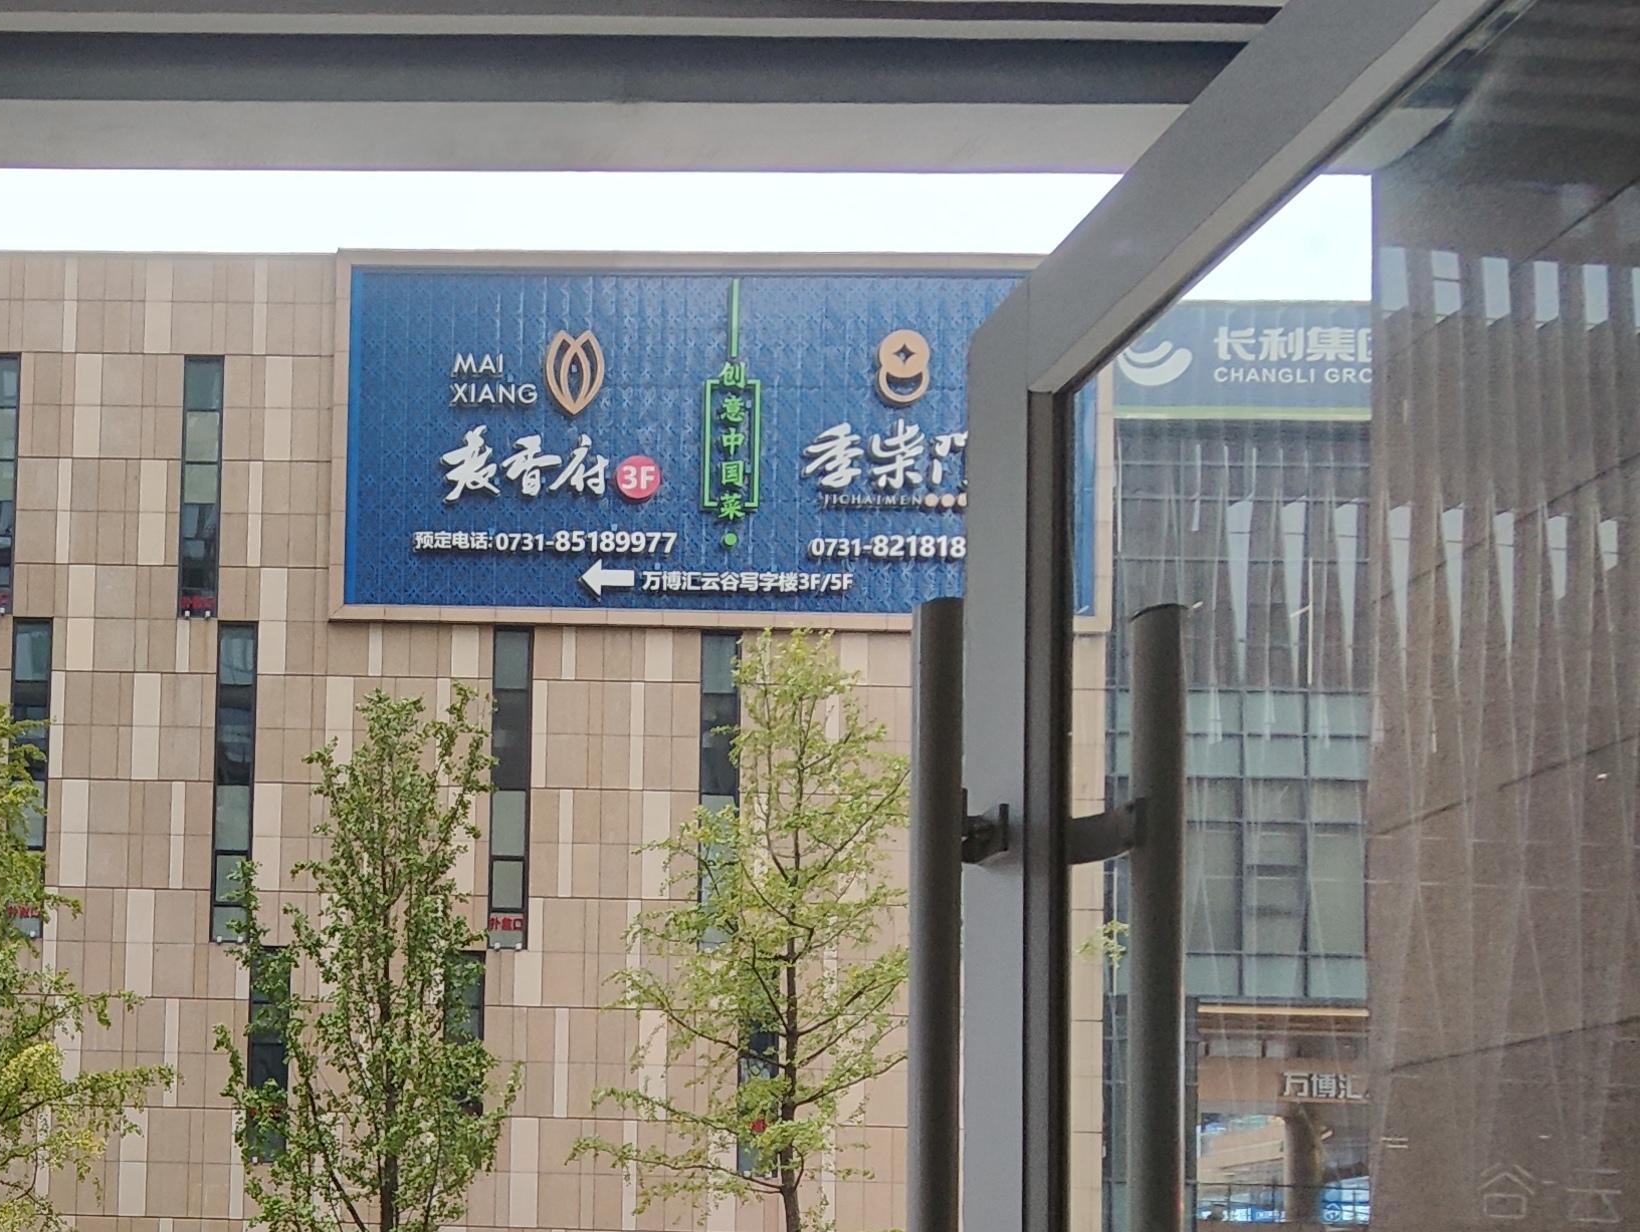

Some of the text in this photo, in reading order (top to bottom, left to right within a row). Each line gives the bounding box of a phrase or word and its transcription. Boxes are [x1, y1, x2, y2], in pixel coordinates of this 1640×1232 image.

[452, 353, 504, 374] MAI
[1213, 366, 1315, 384] CHANGLI
[451, 383, 538, 404] XIANG
[719, 361, 746, 521] 创意中国菜
[620, 465, 656, 490] 3F
[823, 493, 923, 507] JICHAIMEN
[642, 570, 853, 592] 万博汇云谷写字楼3F/5F
[1282, 1071, 1363, 1099] 万博汇
